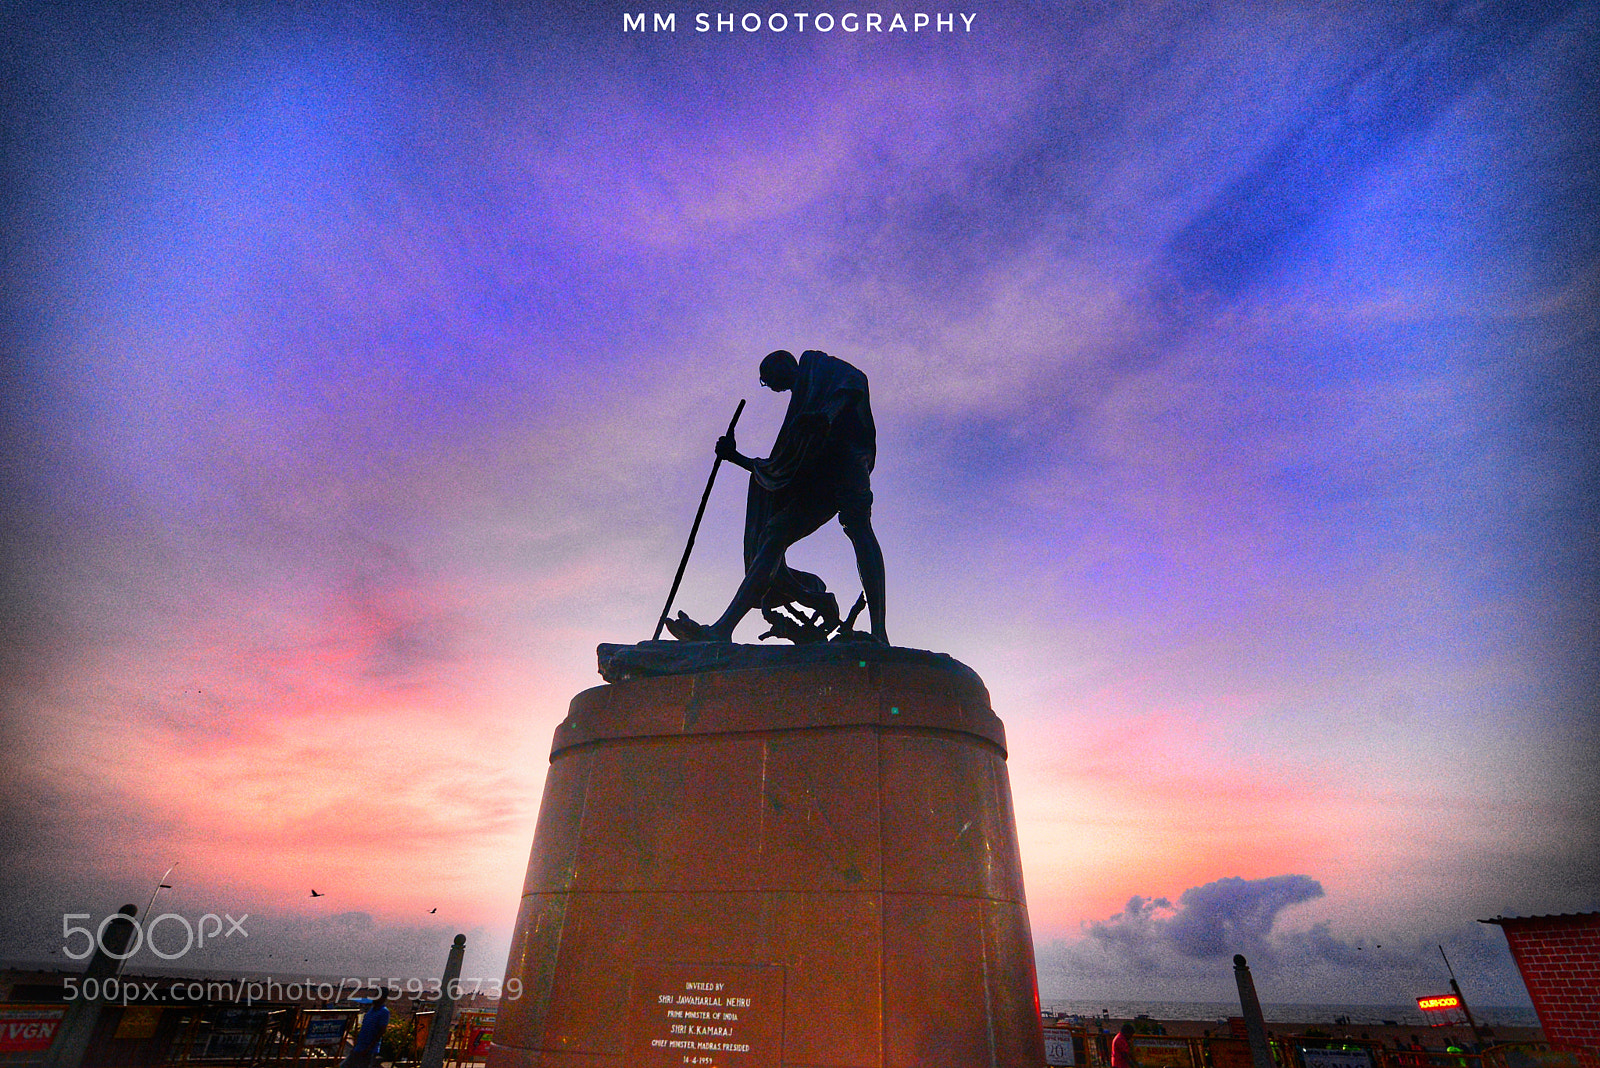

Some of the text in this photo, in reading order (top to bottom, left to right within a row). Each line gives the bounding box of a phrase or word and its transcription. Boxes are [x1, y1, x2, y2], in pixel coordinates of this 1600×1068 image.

[686, 982, 725, 991] UNVEILED BY
[658, 995, 751, 1007] SHRI JAWAHARLAL NEHRU
[667, 1010, 738, 1021] PRIME MINISTER OF INDIA
[9, 1022, 57, 1040] VGN
[670, 1024, 687, 1034] SHRI
[651, 1039, 668, 1047] CHIEF
[722, 1043, 750, 1052] PRESIDED
